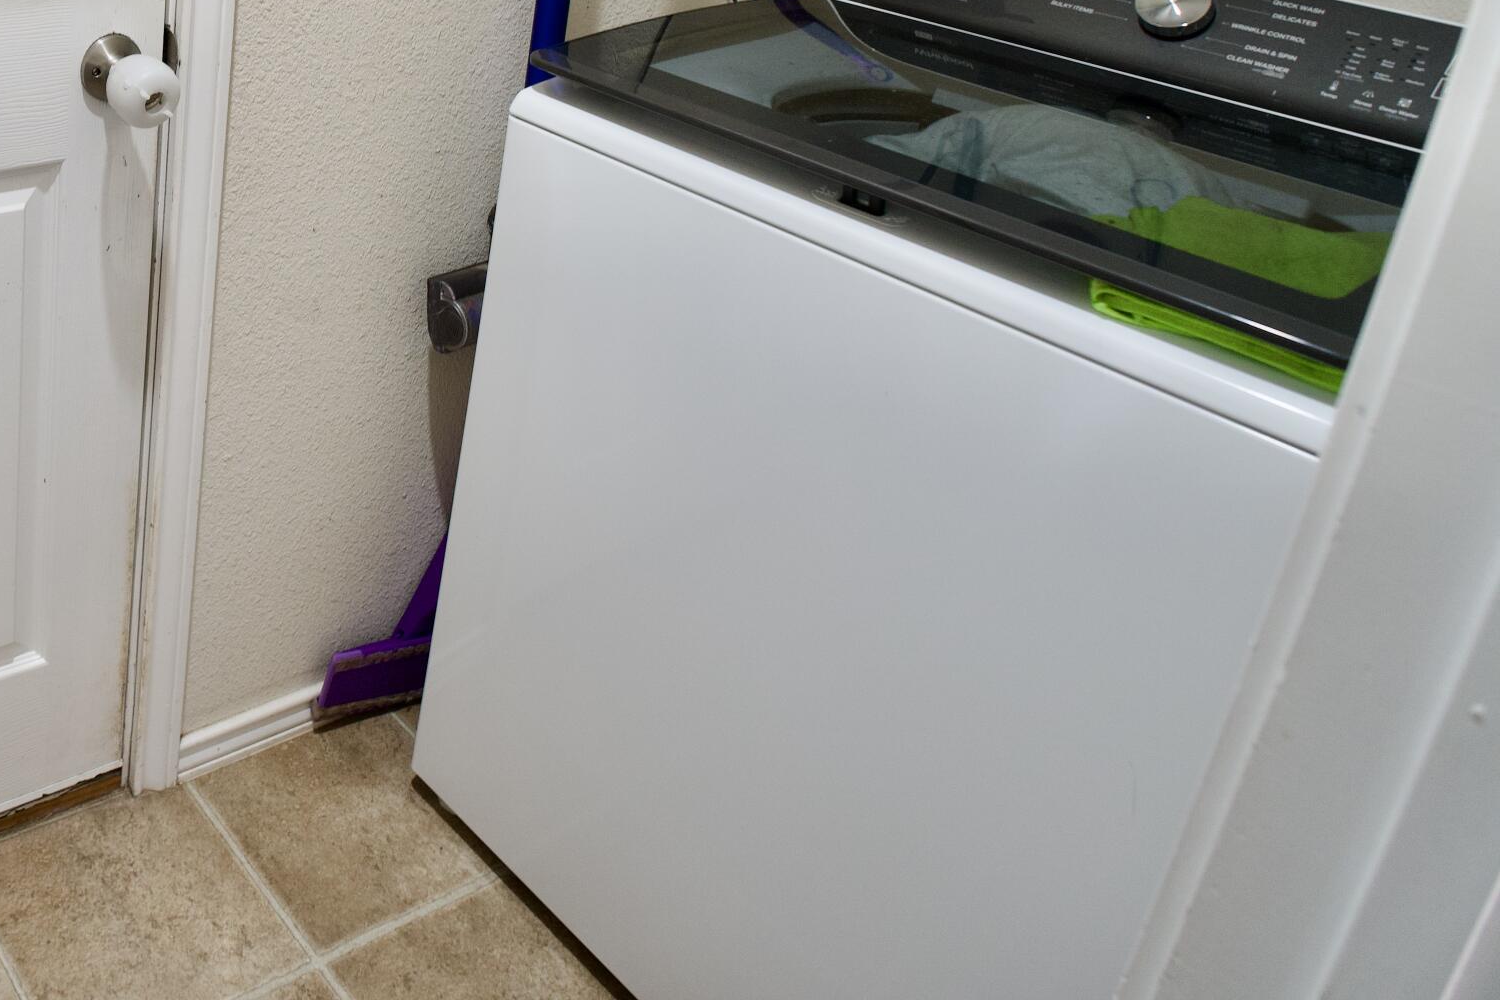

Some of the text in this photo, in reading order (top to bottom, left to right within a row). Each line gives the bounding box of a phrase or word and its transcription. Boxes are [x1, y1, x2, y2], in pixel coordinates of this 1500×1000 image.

[1050, 0, 1094, 14] BULKY ITEMS
[1272, 0, 1326, 15] QUICK WASH
[1271, 12, 1319, 28] DELICATES
[1231, 22, 1306, 45] WRINKLE CONTROL
[1244, 44, 1270, 56] DRAIN
[1277, 51, 1298, 62] SPIN
[1226, 54, 1253, 66] CLEAN
[1254, 60, 1290, 74] WASHER
